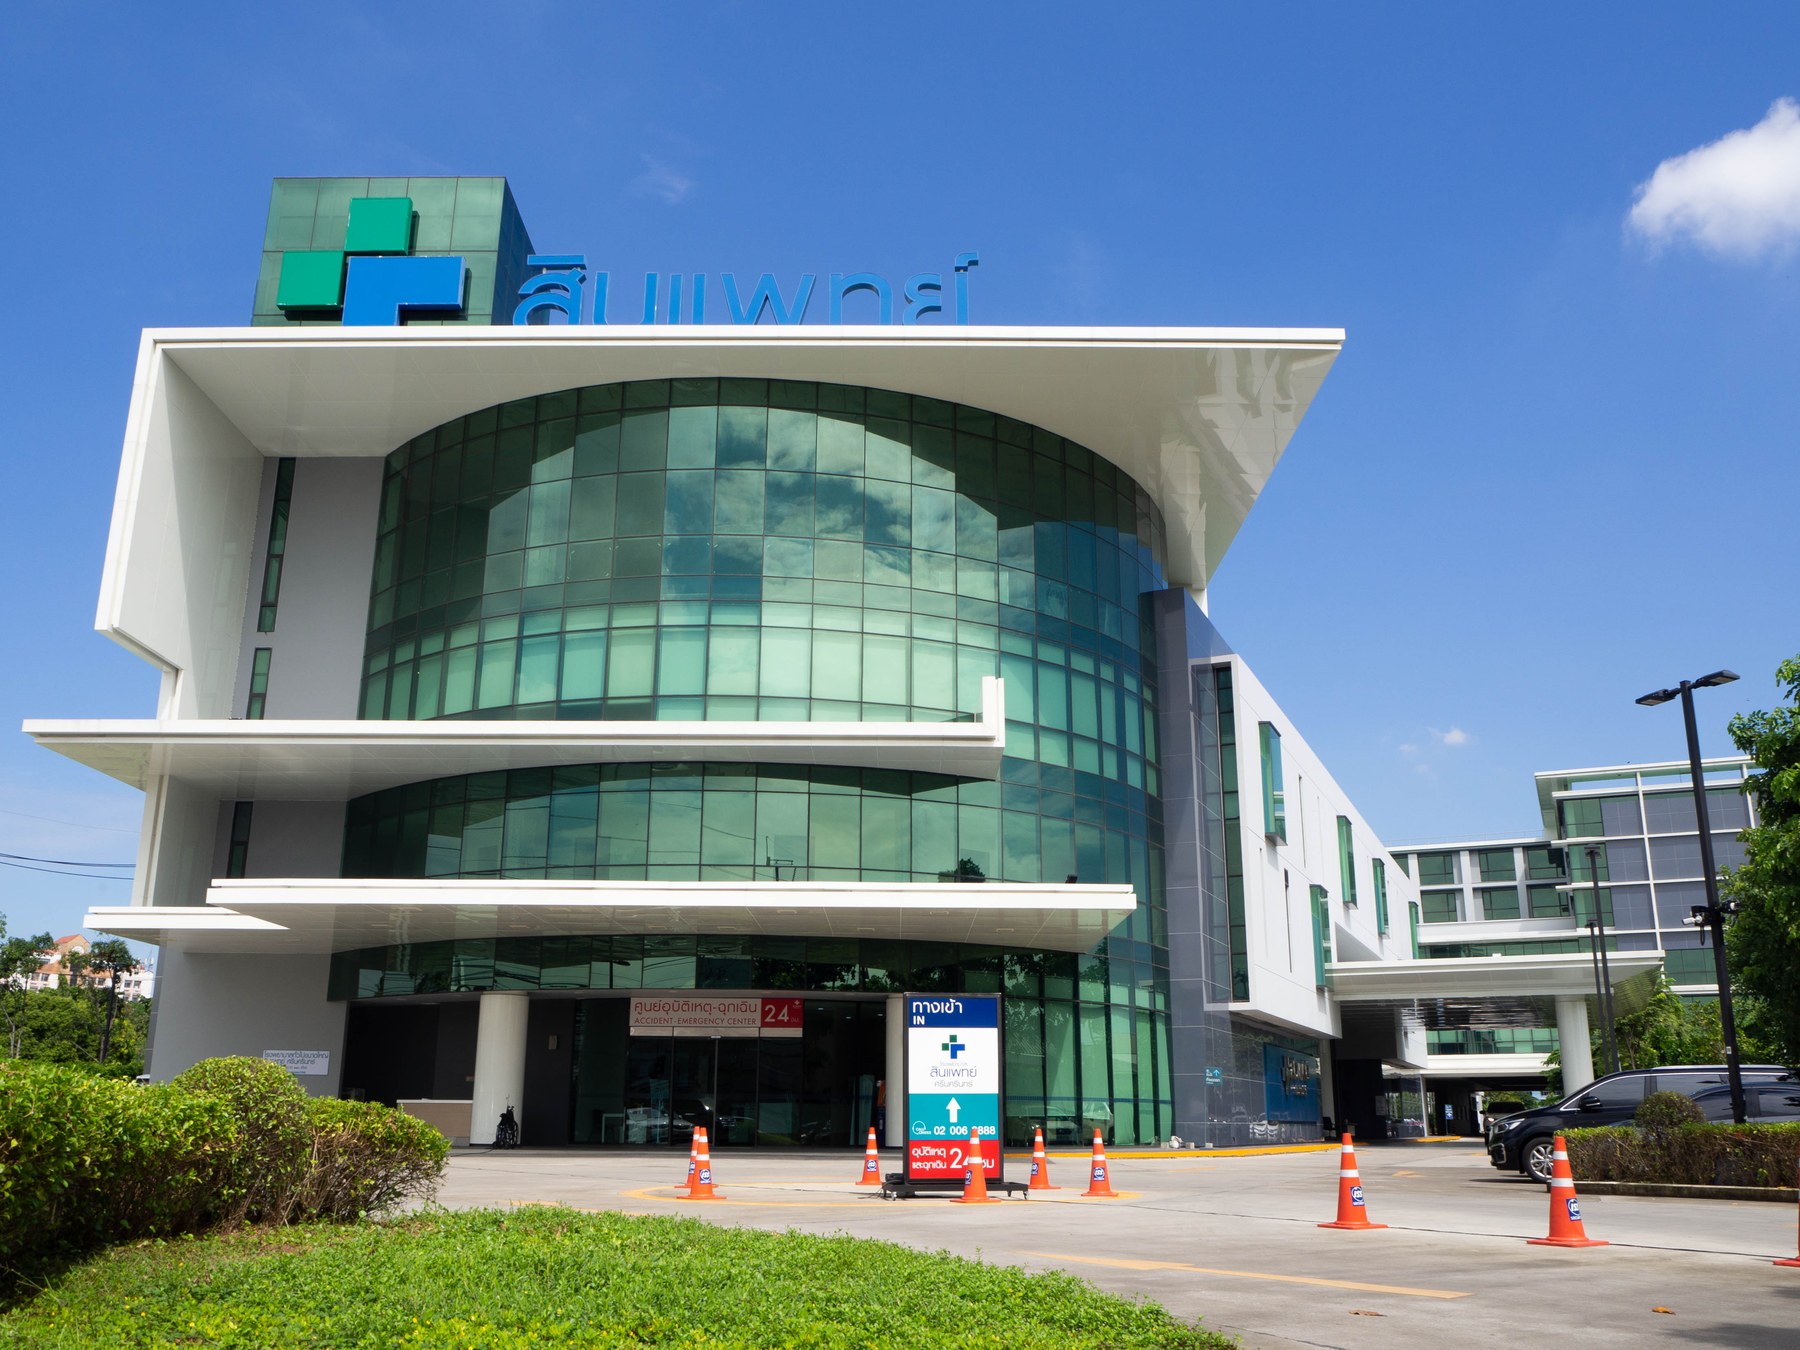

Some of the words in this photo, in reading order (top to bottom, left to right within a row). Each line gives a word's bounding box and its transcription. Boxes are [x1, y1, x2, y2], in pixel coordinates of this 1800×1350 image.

[634, 1000, 757, 1016] ศูนย์อุบัติเหตุ-ฉุกเฉิน
[912, 999, 963, 1014] ทางเข้า
[764, 1005, 789, 1022] 24
[913, 1016, 925, 1025] IN
[930, 1066, 978, 1078] สินแพทย์
[933, 1125, 946, 1135] 02
[949, 1125, 968, 1135] 006
[971, 1125, 996, 1135] 888
[912, 1146, 947, 1158] อุบัติเหตุ
[912, 1159, 947, 1171] และฉุกเฉิน
